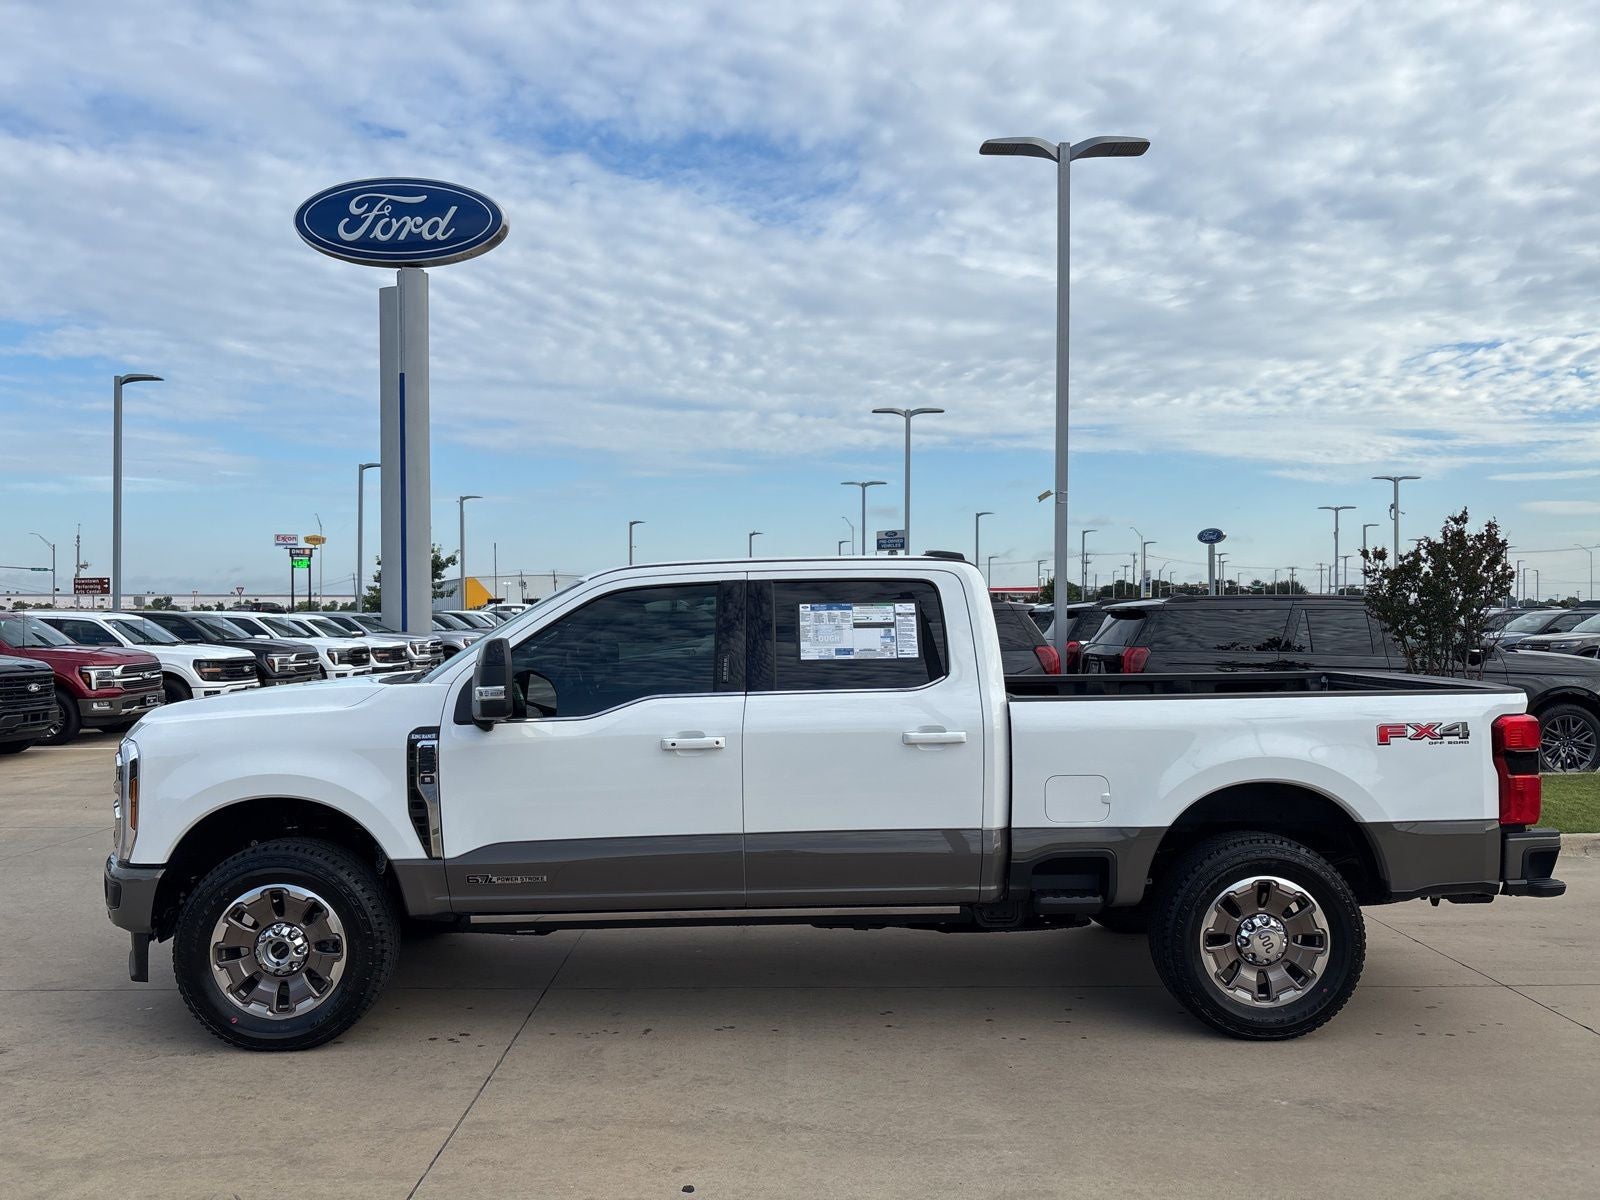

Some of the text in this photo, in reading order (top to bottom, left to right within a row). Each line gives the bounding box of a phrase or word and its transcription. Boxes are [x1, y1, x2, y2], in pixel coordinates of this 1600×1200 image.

[337, 193, 458, 242] Ford
[276, 535, 297, 543] Exxon
[1376, 722, 1470, 745] FX4
